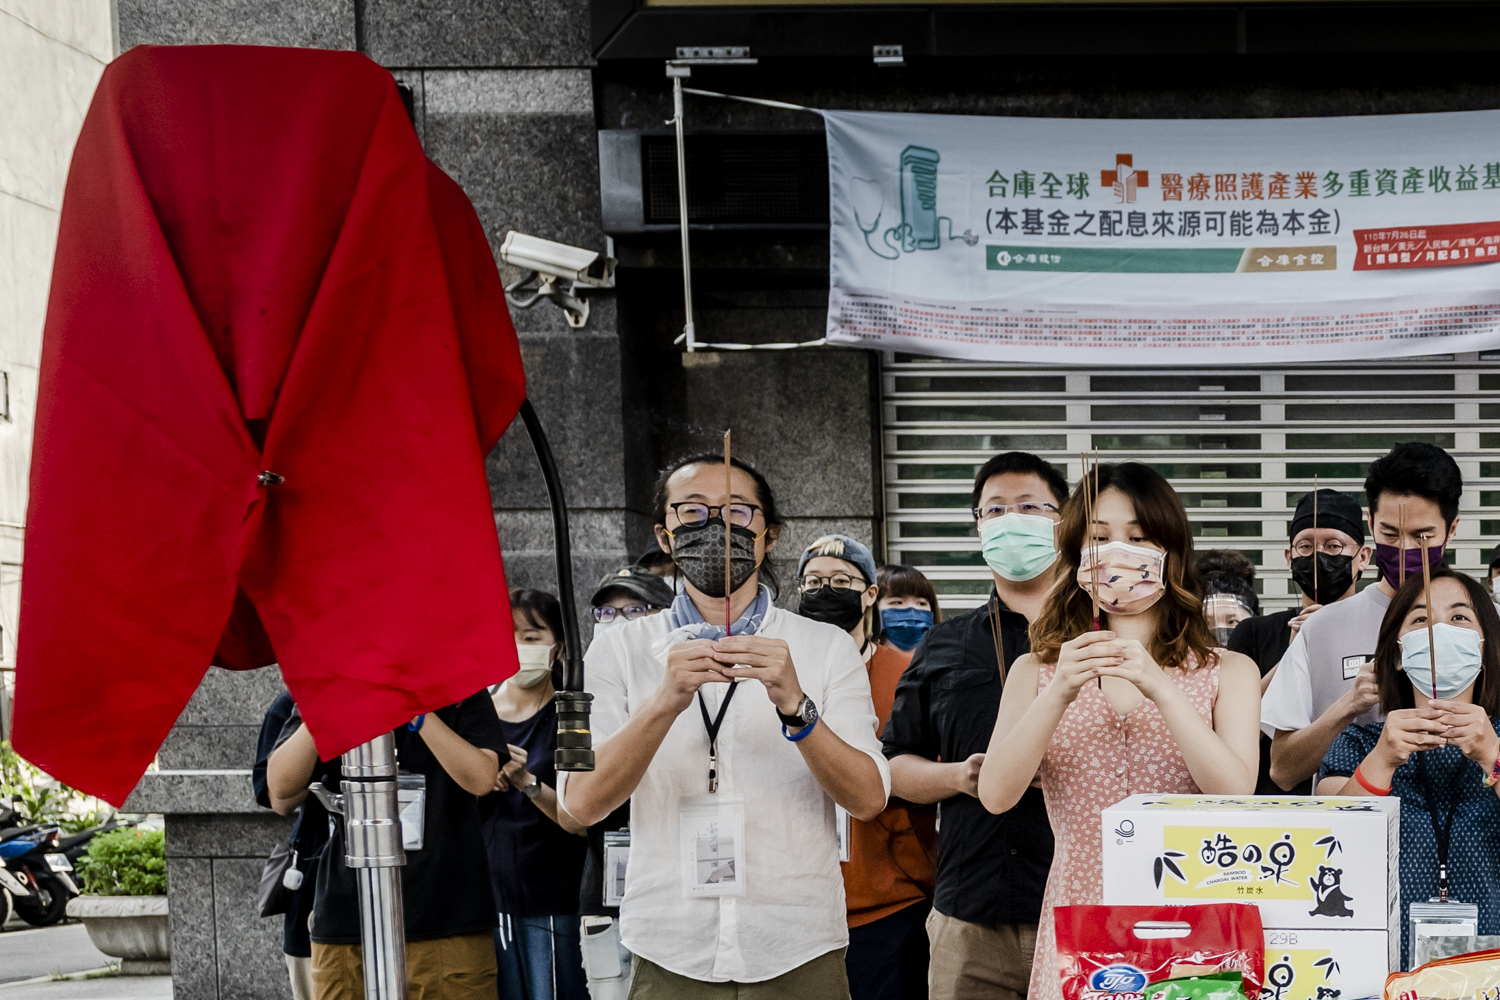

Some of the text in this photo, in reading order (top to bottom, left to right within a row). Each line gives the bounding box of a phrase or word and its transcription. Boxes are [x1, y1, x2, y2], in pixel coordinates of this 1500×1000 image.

[985, 169, 1090, 200] 合庫全球
[985, 206, 1341, 238] (本基金之配息來源可能為本金)
[1201, 833, 1300, 886] 酷の泉
[1222, 869, 1247, 877] BAMBOO
[1231, 874, 1248, 883] WATER
[1236, 885, 1264, 895] 竹炭水
[1269, 932, 1299, 946] 29B
